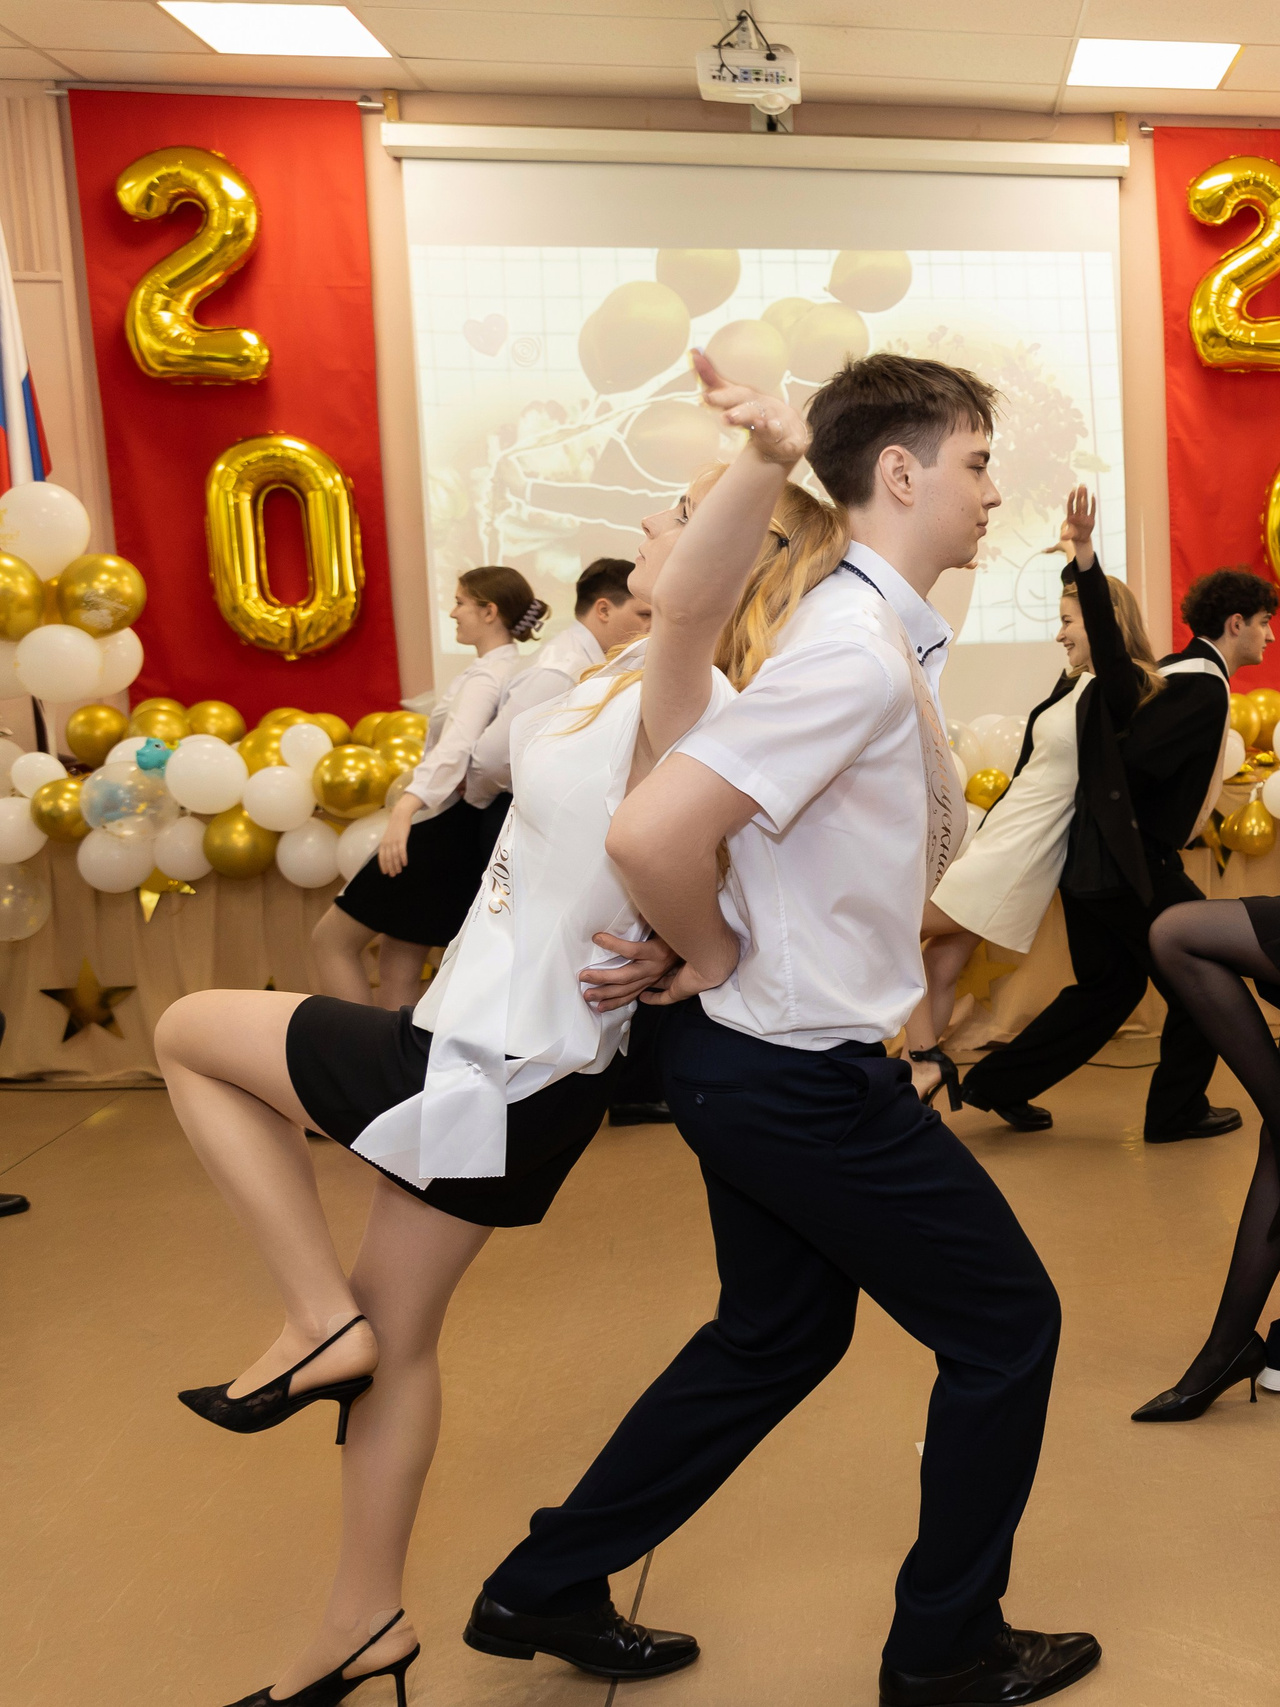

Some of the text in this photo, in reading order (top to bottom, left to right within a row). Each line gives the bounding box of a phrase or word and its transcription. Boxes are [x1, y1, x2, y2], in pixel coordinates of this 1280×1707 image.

[115, 147, 271, 386] 2
[206, 432, 366, 661] 0
[487, 843, 512, 916] 2026
